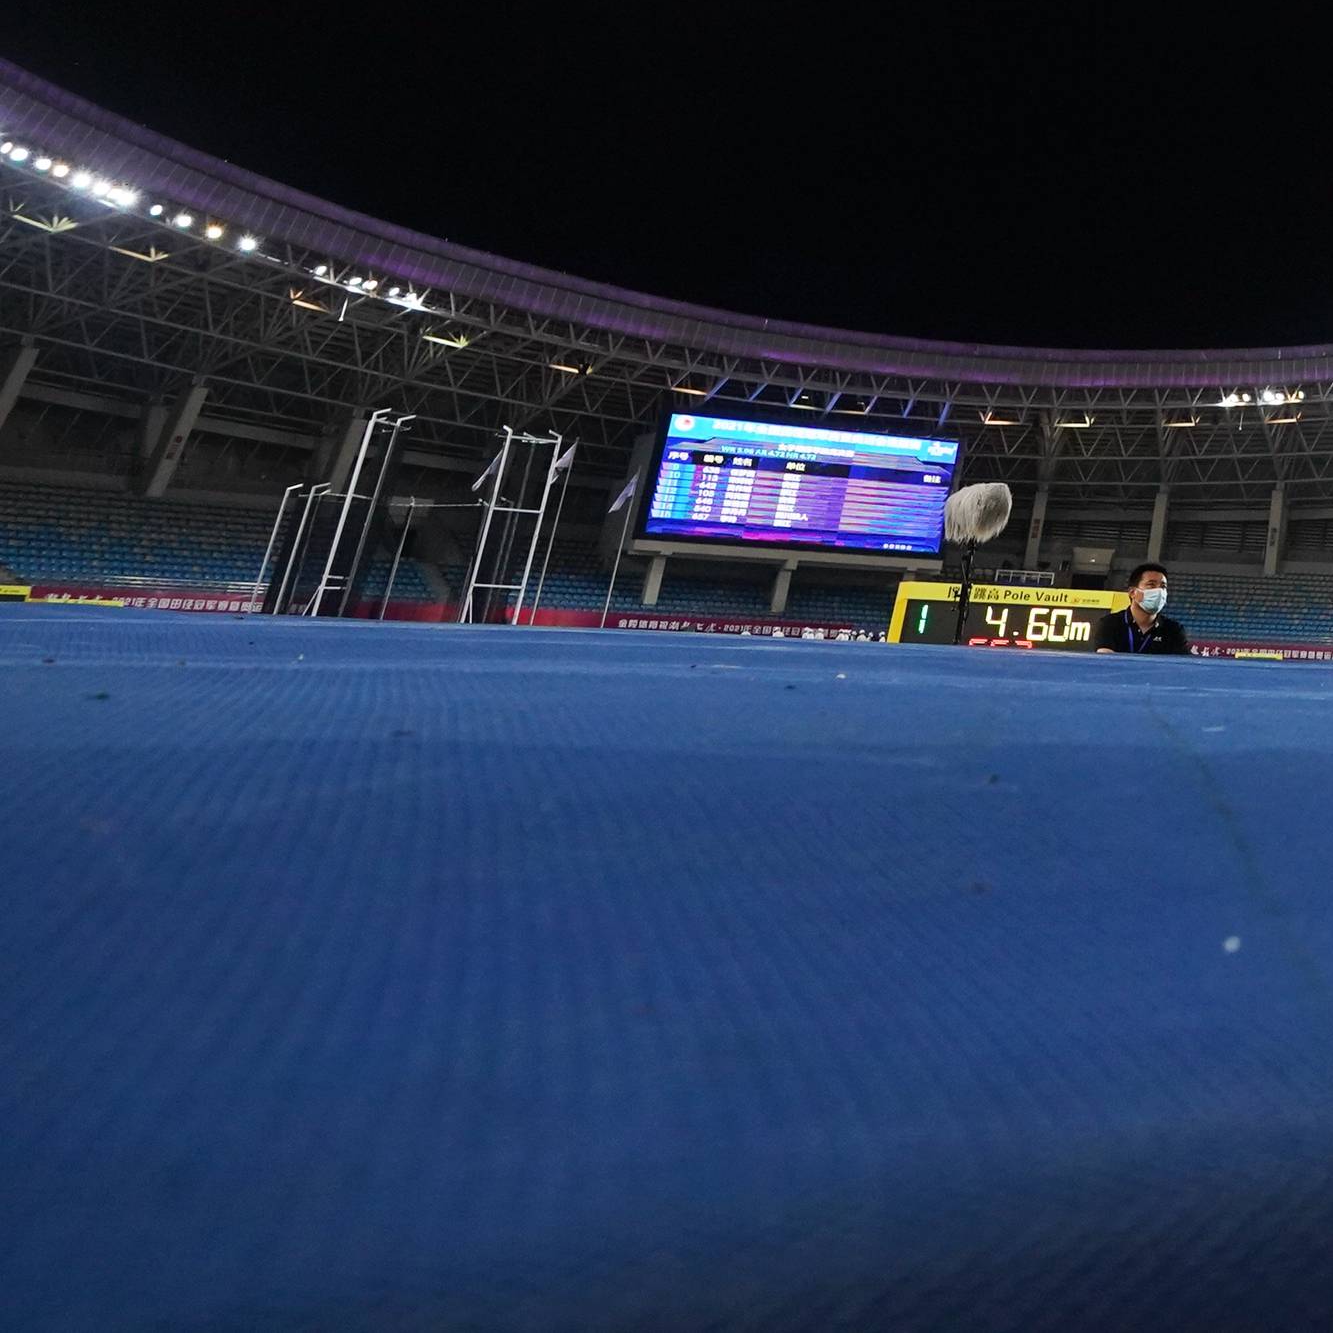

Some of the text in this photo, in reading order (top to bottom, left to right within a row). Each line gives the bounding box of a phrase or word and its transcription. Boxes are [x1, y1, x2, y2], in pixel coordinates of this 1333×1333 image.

[1003, 589, 1031, 601] Pole
[1035, 591, 1068, 603] Vault
[919, 604, 929, 634] 1
